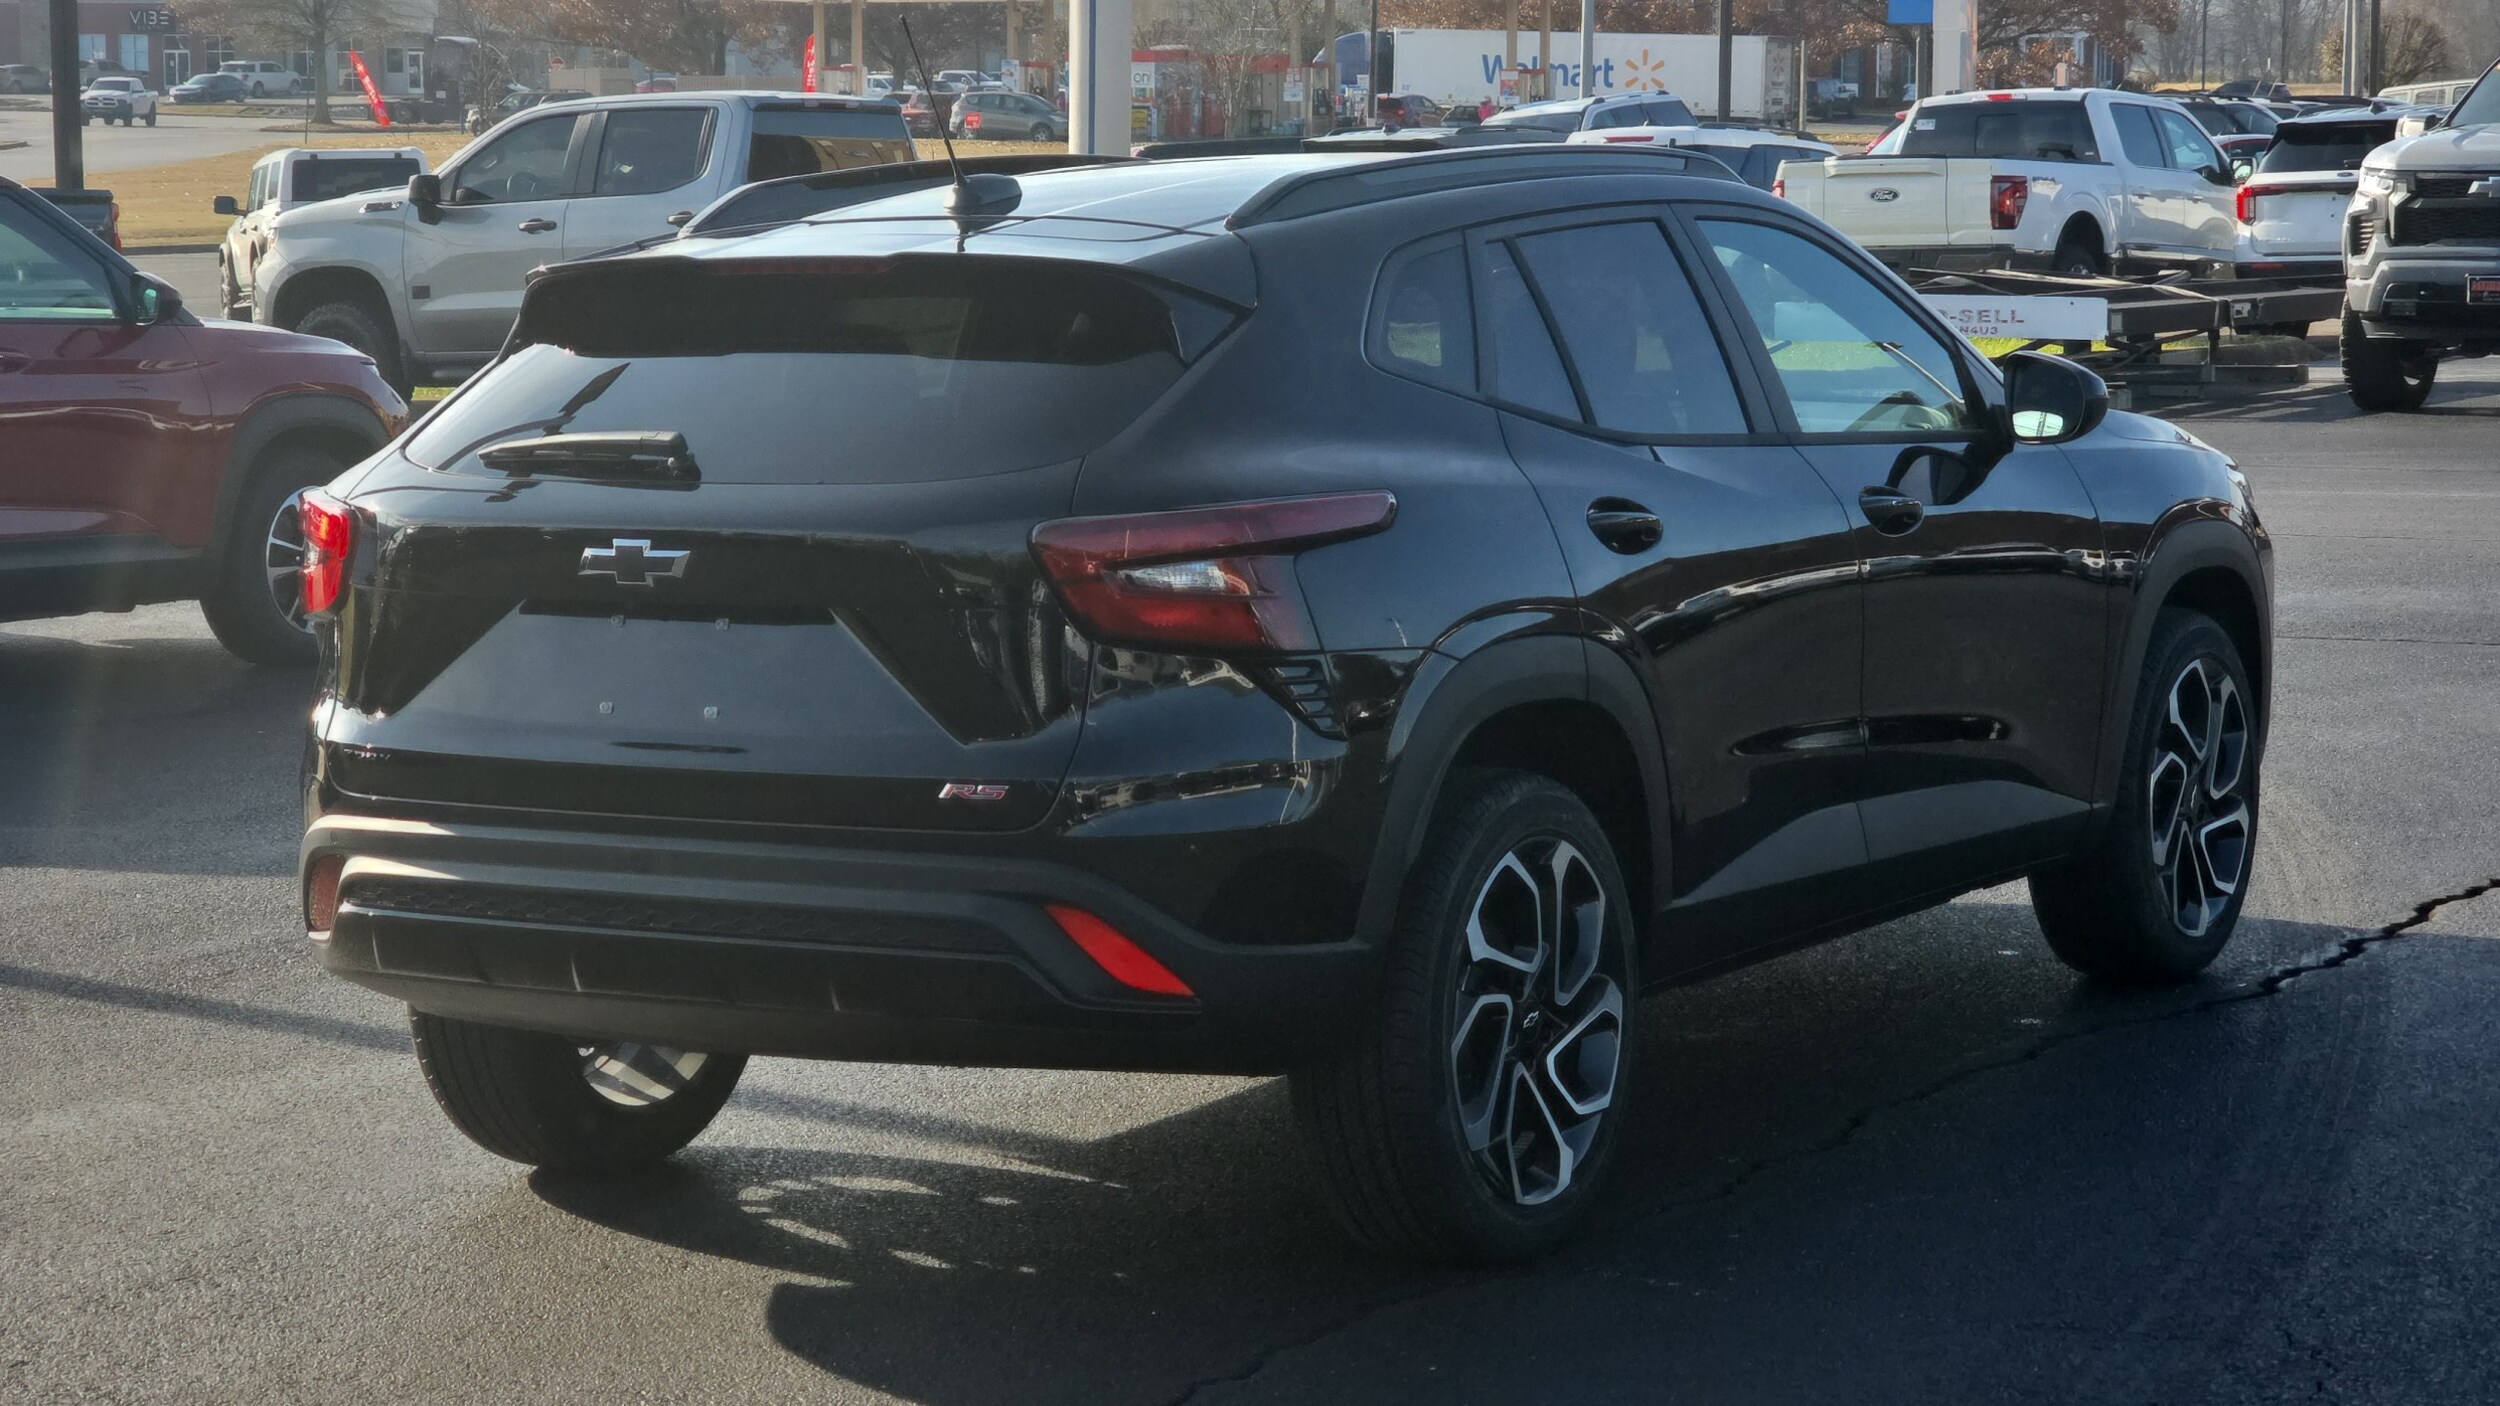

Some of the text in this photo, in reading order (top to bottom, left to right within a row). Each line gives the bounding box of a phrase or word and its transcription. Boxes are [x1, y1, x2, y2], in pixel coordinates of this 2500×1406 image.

[130, 10, 169, 25] VIBE
[1482, 54, 1614, 88] Wmart
[1955, 326, 1999, 335] N4U3
[938, 782, 1010, 800] RS
